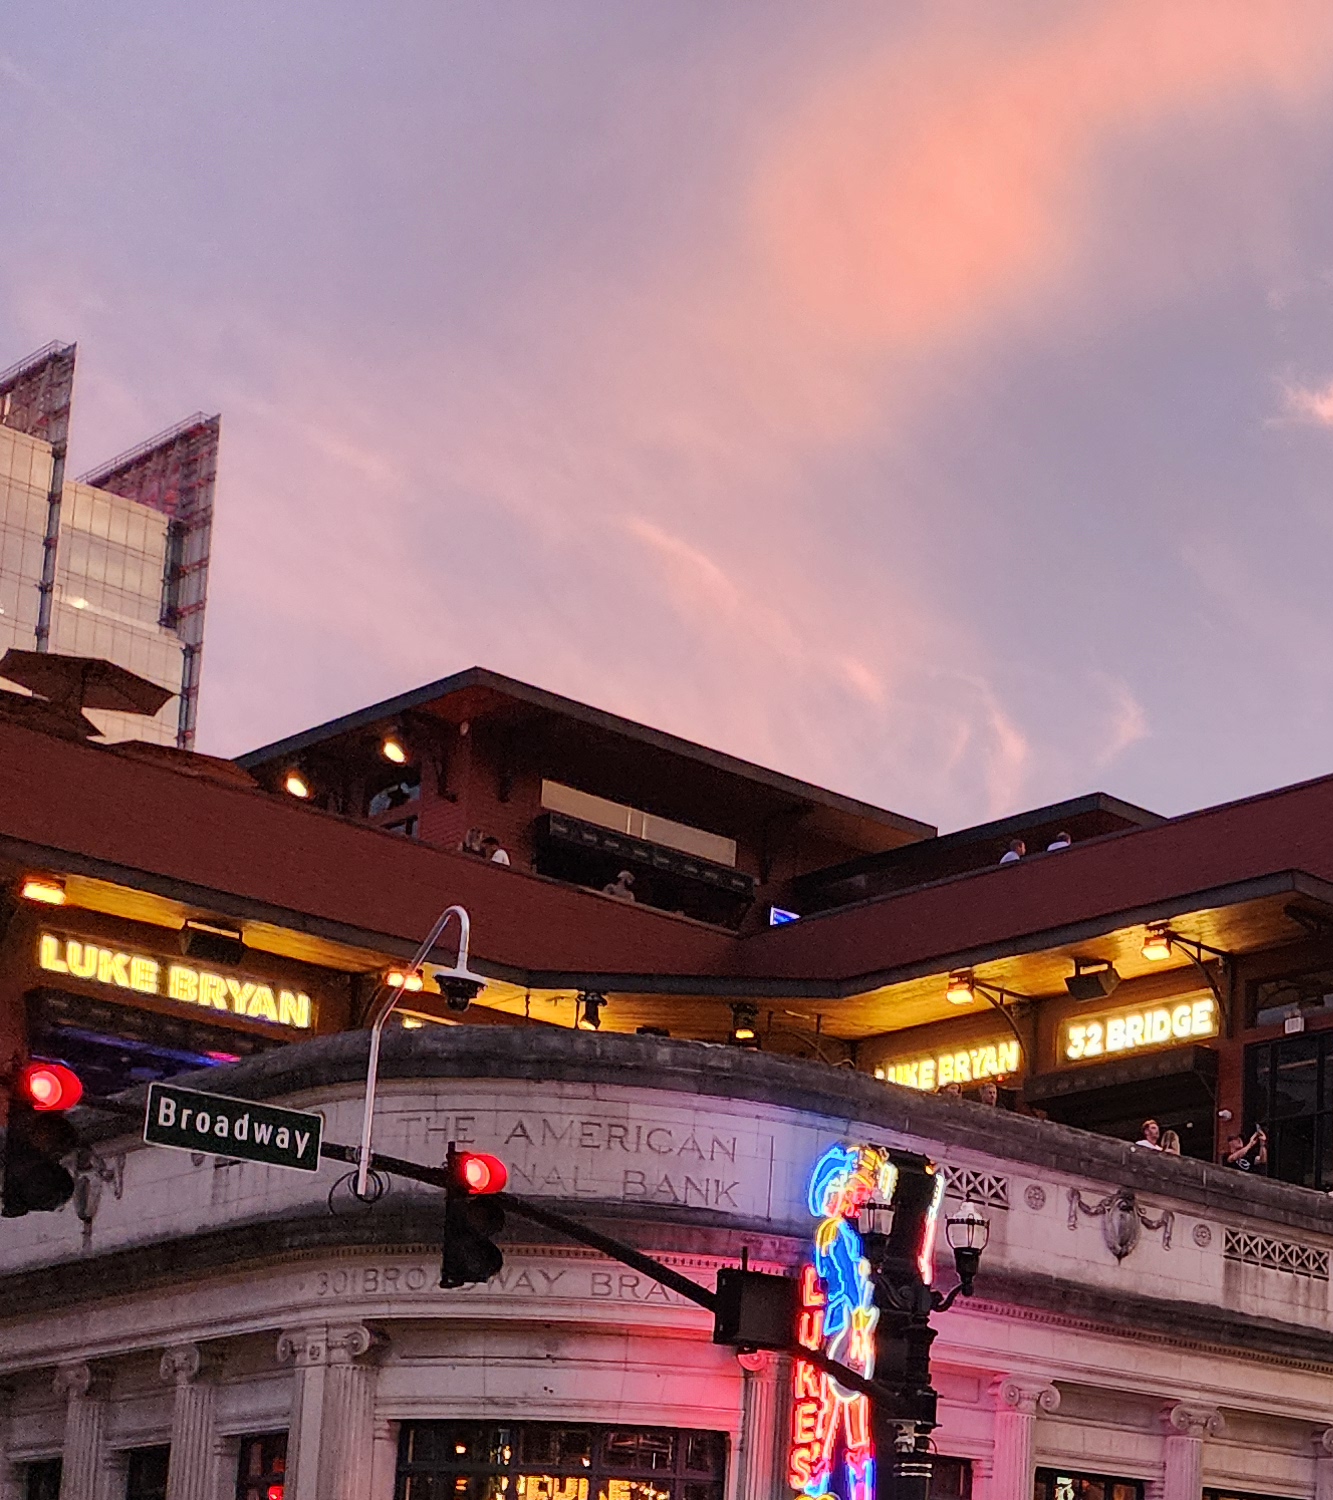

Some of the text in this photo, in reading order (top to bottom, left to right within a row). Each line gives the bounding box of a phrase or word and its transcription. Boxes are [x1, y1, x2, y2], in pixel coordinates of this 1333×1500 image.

[39, 934, 312, 1029] LUKE BRYAN
[1066, 998, 1215, 1061] 32 BRIDGE
[874, 1041, 1020, 1091] UKE BRYAN
[157, 1095, 311, 1159] Broadway
[397, 1116, 737, 1164] THE AMERICAN
[622, 1168, 741, 1208] BANK
[362, 1267, 567, 1294] BROWAY
